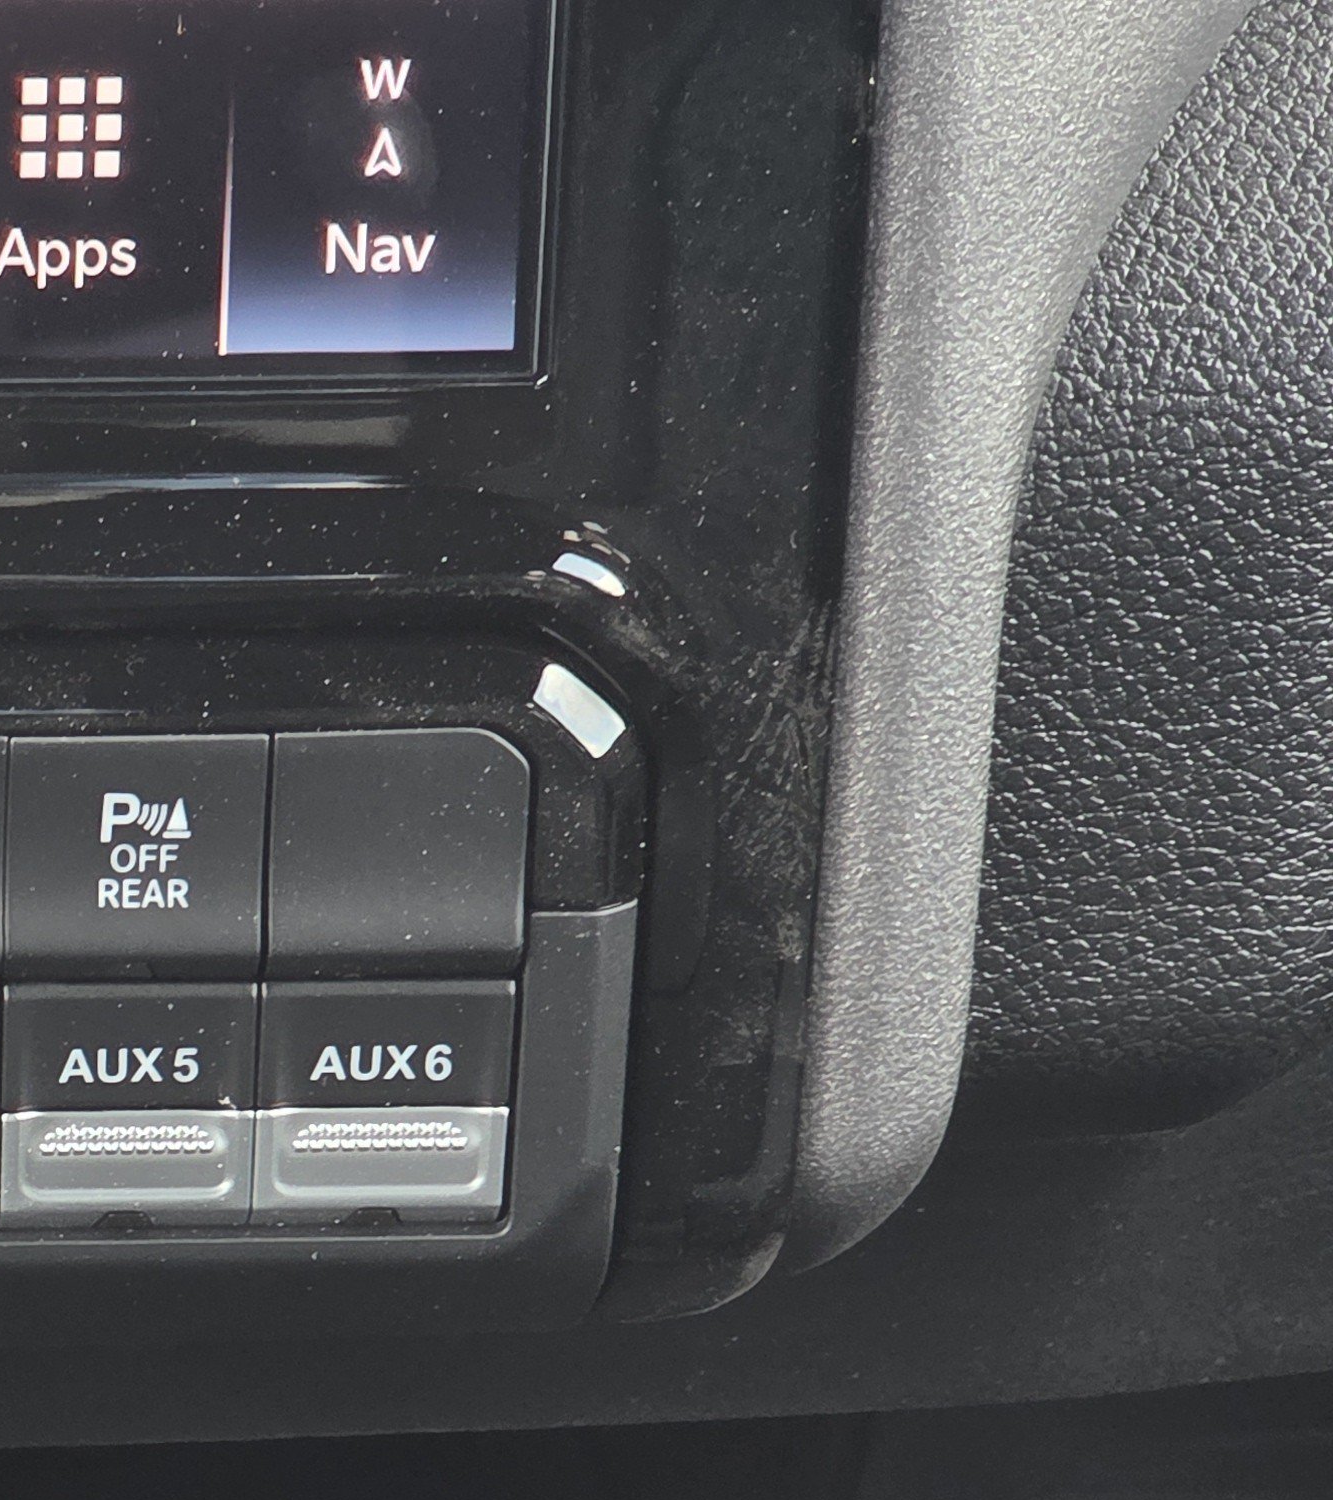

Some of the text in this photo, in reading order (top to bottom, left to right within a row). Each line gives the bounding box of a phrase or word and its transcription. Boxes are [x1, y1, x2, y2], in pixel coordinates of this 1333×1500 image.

[360, 58, 412, 100] W
[325, 222, 436, 274] Nav
[100, 792, 140, 843] P
[110, 843, 179, 874] OFF
[98, 878, 189, 909] REAR
[58, 1047, 199, 1084] AUX 5
[309, 1043, 452, 1081] AUX 6
